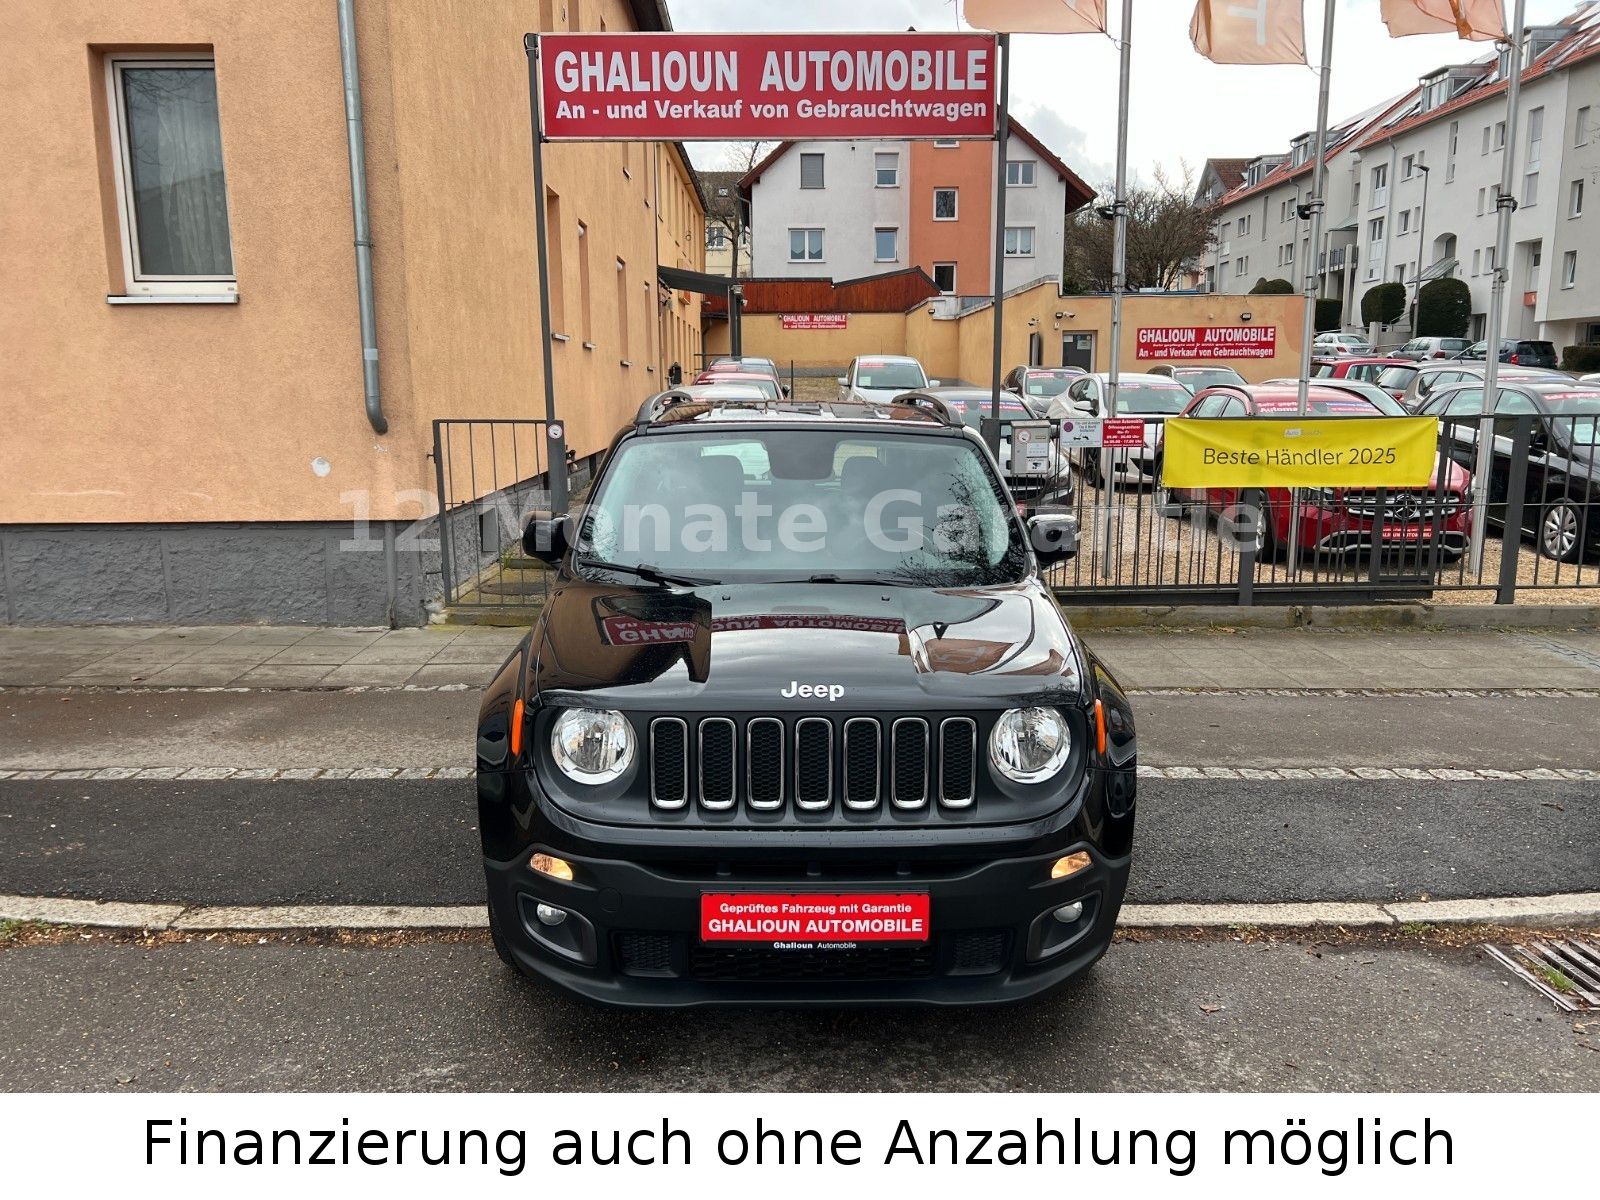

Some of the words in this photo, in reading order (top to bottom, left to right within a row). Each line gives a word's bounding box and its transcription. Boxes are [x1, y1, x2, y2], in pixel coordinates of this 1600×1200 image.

[554, 50, 738, 93] GHALIOUN
[759, 49, 987, 92] AUTOMOBILE
[556, 100, 586, 119] An
[606, 100, 647, 119] und
[654, 99, 743, 119] Verkauf
[750, 104, 789, 118] von
[796, 98, 986, 122] Gebrauchtwagen
[1139, 329, 1196, 343] GHALIOUN
[1204, 328, 1275, 342] AUTOMOBILE
[1139, 348, 1149, 358] An
[1155, 348, 1168, 357] und
[1170, 347, 1198, 358] Verkauf
[1199, 349, 1212, 357] von
[1213, 347, 1273, 359] Gebrauchtwagen
[1203, 448, 1260, 465] Beste
[1266, 448, 1343, 466] Händler
[1349, 447, 1397, 465] 2025
[780, 680, 845, 702] Jeep
[719, 902, 779, 915] Geprüftes
[781, 903, 837, 915] Fahrzeug
[839, 903, 859, 913] mit
[861, 903, 912, 913] Garantie
[708, 918, 800, 933] GHALIOUN
[805, 918, 923, 933] AUTOMOBILE
[773, 941, 814, 949] Ghalioun
[816, 941, 857, 949] Automobile
